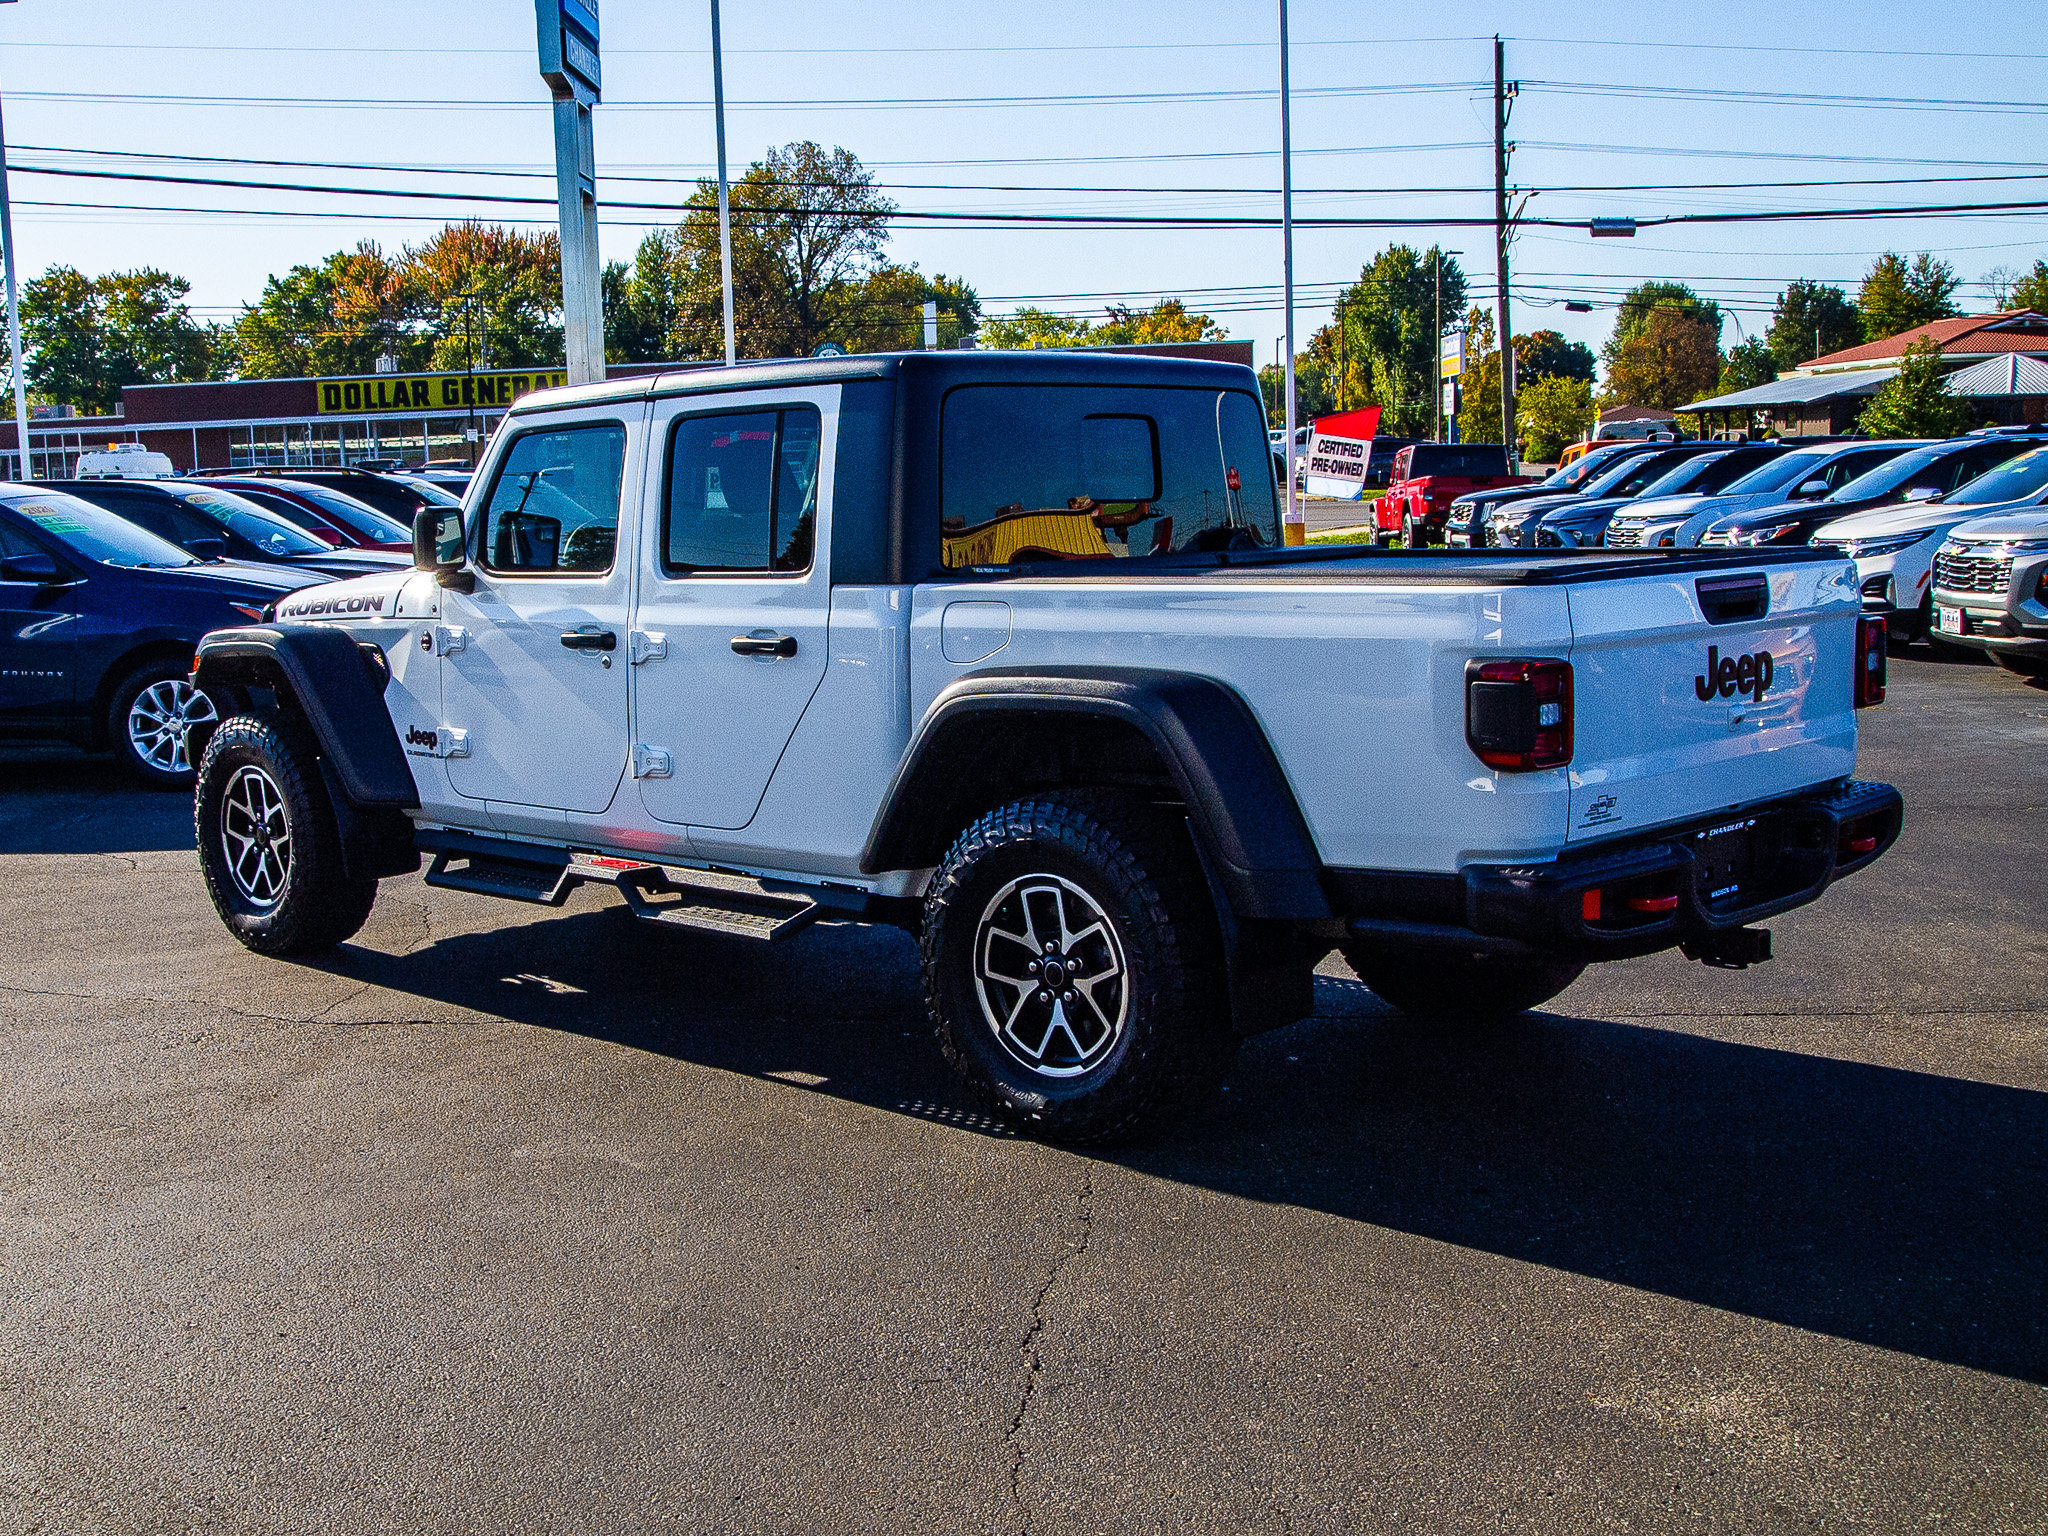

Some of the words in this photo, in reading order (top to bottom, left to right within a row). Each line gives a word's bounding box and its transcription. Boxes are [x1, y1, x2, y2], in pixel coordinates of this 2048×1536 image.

[323, 380, 431, 411] DOLLAR
[1318, 439, 1363, 458] CERTIFIED
[1311, 457, 1363, 476] PRE-OWNED
[281, 595, 385, 618] RUBICON
[1695, 645, 1774, 702] Jeep
[406, 725, 437, 750] Jeep
[1709, 821, 1745, 836] CHANDLER
